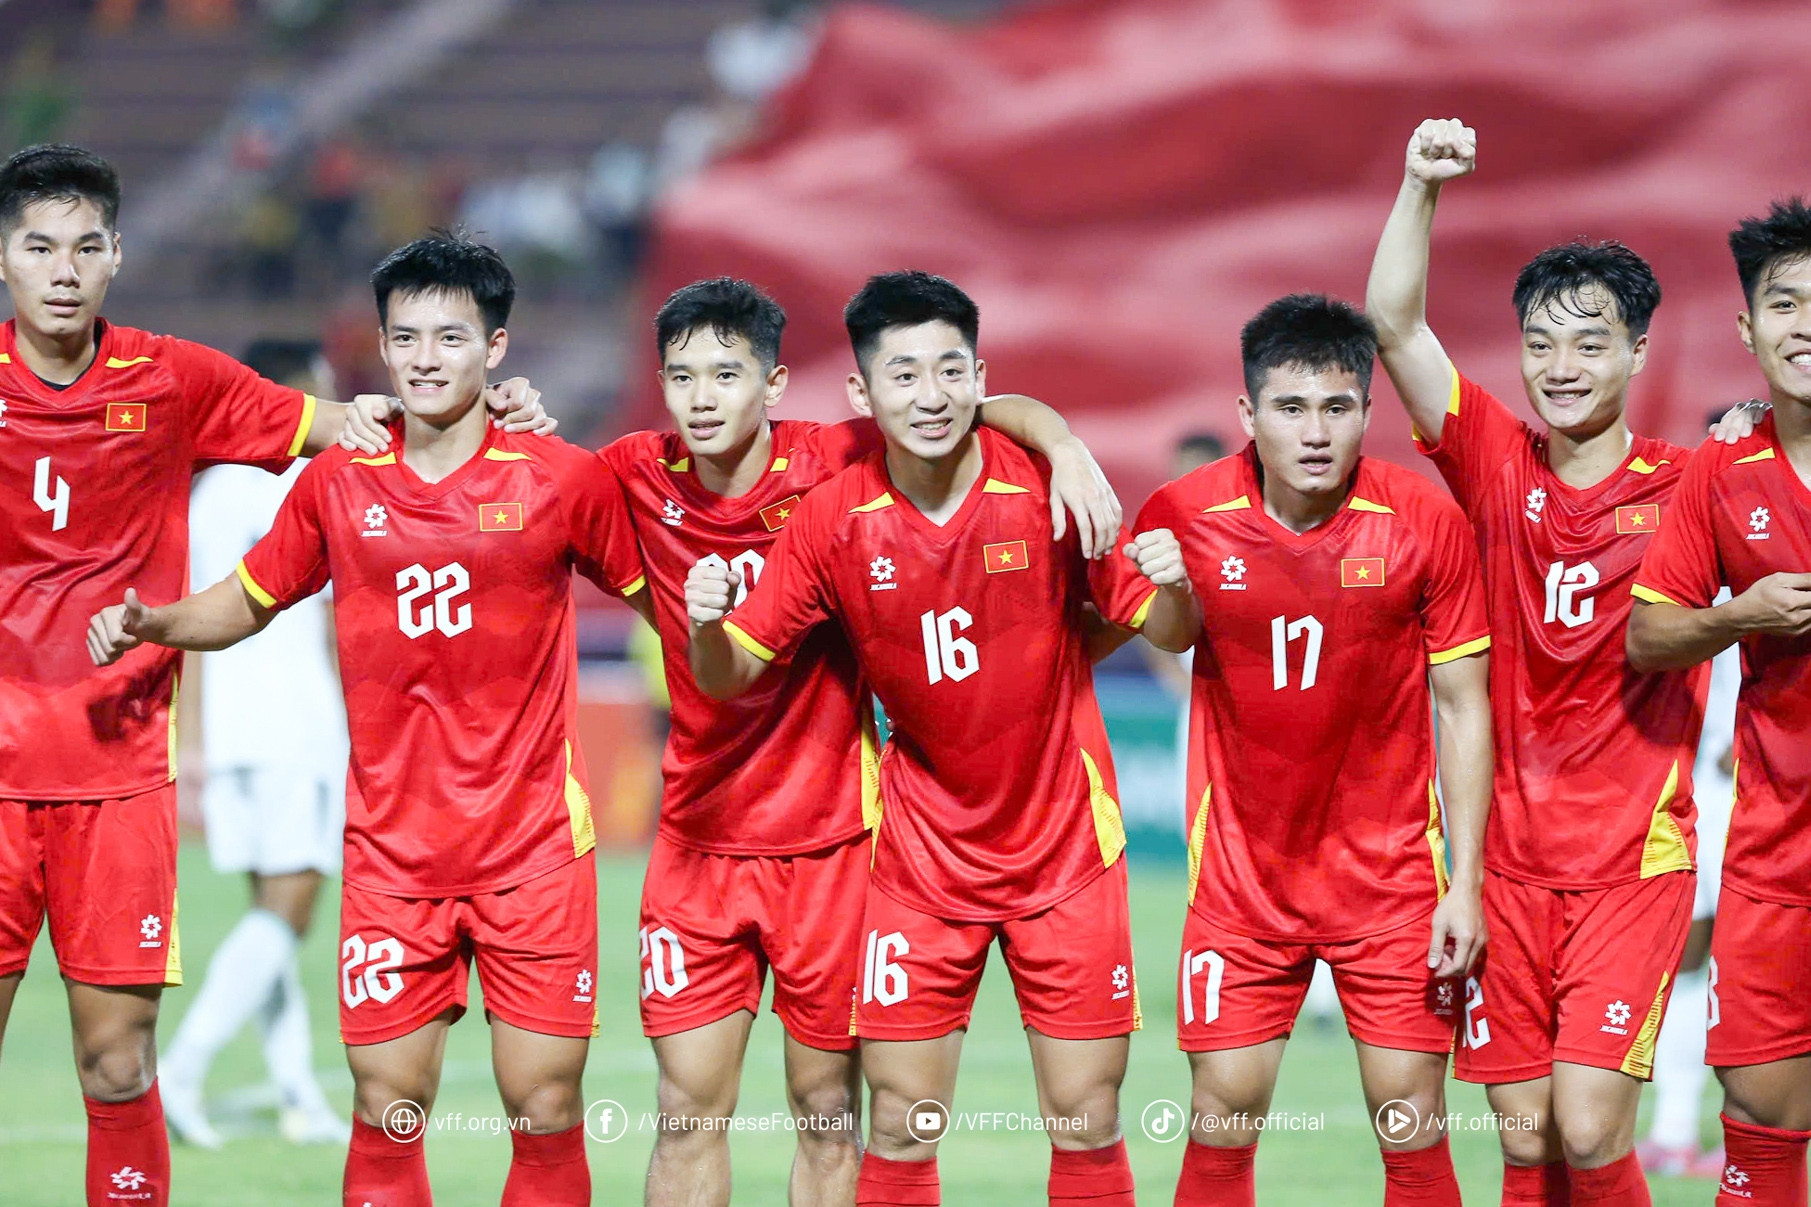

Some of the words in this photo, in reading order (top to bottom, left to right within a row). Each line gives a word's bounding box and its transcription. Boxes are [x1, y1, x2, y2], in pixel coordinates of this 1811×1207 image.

[33, 456, 71, 532] 4
[395, 561, 473, 640] 22
[1543, 560, 1600, 629] 12
[920, 605, 980, 685] 16
[1271, 614, 1324, 691] 17
[341, 933, 405, 1010] 22
[861, 929, 910, 1007] 16
[1181, 948, 1225, 1025] 17
